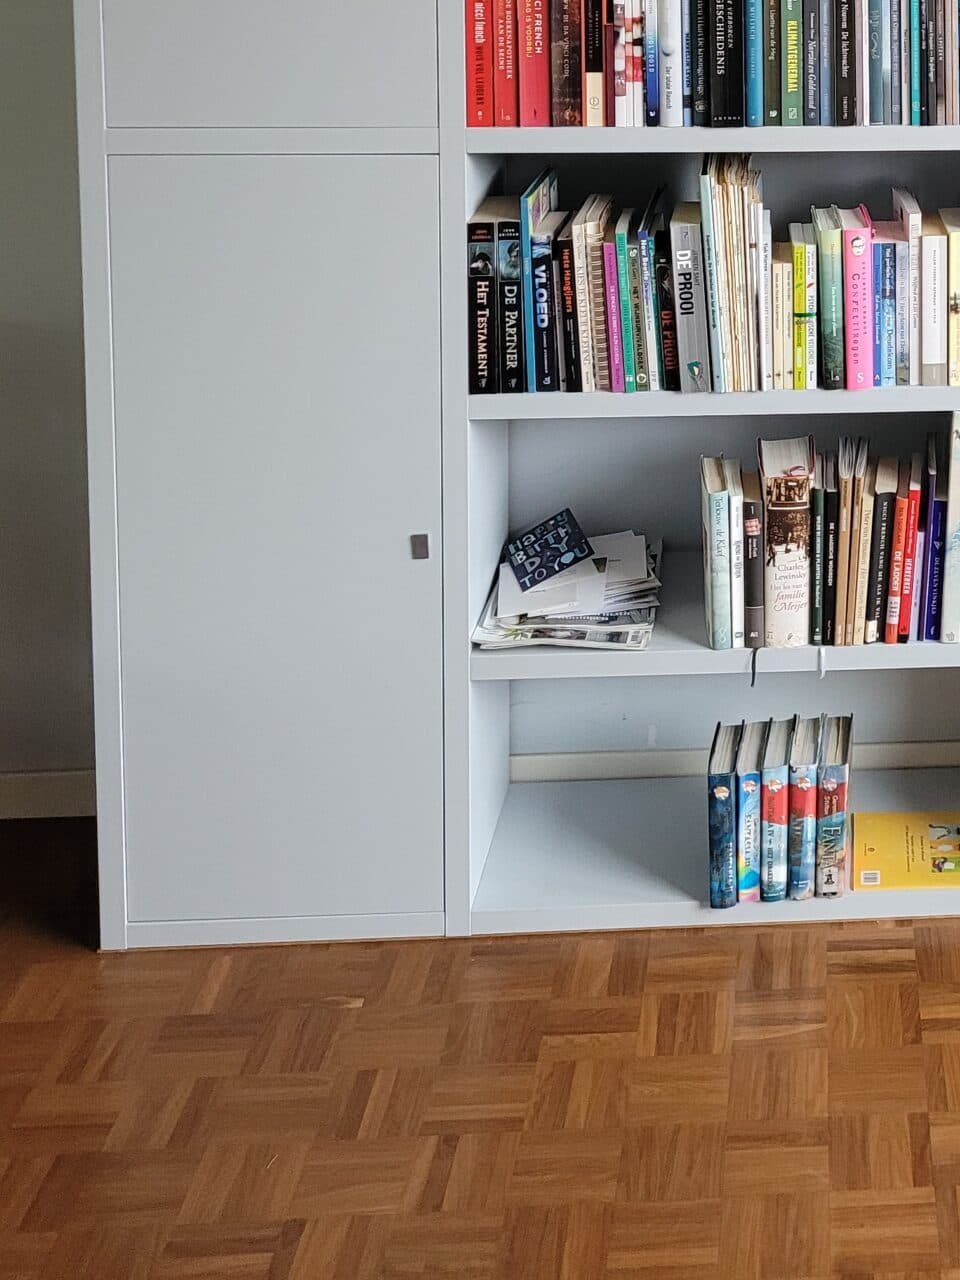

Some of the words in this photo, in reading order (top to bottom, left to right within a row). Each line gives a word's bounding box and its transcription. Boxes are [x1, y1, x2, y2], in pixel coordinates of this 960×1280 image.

[474, 2, 486, 20] nicci
[749, 7, 757, 40] MULISCH
[769, 9, 777, 28] Lisette
[475, 21, 487, 44] french
[499, 37, 505, 47] DE
[505, 10, 513, 79] BOEKENAPOTHEEK
[534, 13, 544, 54] FRENCH
[842, 31, 849, 41] De
[787, 20, 798, 93] KLIMAATGENERAAL
[808, 75, 817, 109] Goldmund
[563, 248, 571, 269] Hete
[642, 257, 651, 282] Beetle
[675, 249, 691, 271] DE
[564, 270, 574, 313] Hangijzers
[576, 266, 587, 287] KIES
[534, 264, 548, 328] VLOED
[677, 272, 695, 316] PROOI
[661, 310, 671, 327] DE
[504, 311, 519, 369] PARTNER
[663, 330, 677, 370] PROOI
[713, 496, 724, 526] Terlouw
[880, 523, 888, 550] FRENCH
[519, 568, 547, 589] TO
[548, 544, 590, 571] YOU
[894, 550, 902, 562] DE
[891, 562, 901, 593] LADDER
[902, 558, 913, 595] HERKERKEN
[822, 827, 842, 869] FANTA
